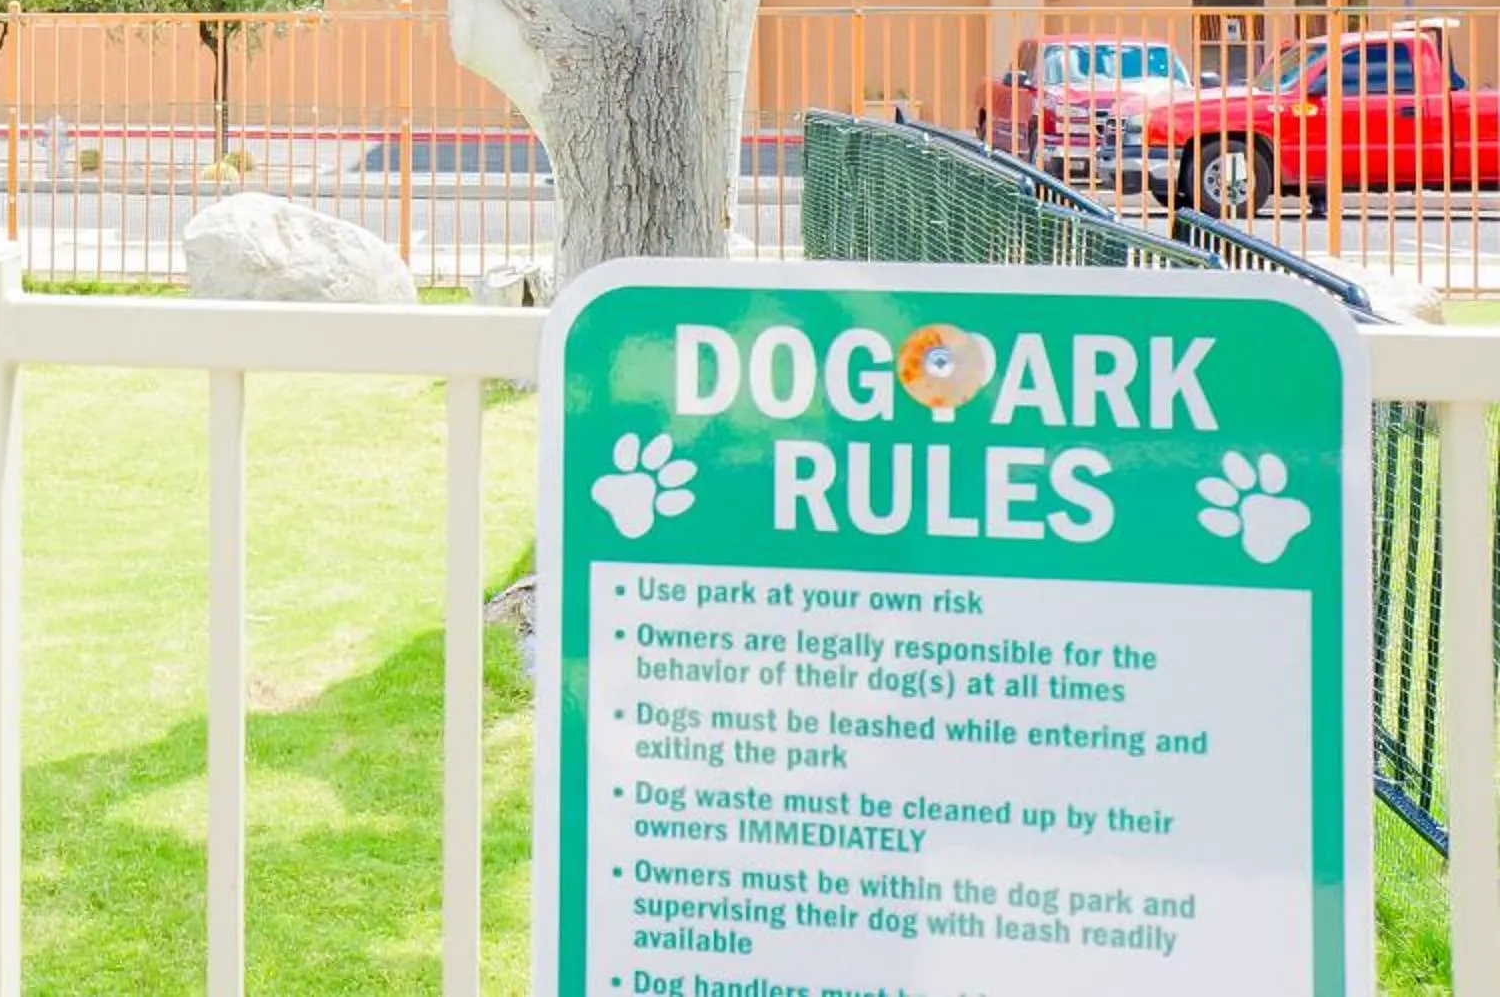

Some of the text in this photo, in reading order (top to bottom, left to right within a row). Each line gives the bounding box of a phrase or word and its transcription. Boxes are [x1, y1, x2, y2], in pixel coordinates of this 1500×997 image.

[675, 323, 895, 422] DOG
[773, 439, 1115, 543] RULES
[637, 574, 984, 615] Use park at your own risk
[636, 622, 1158, 671] Owners are legally responsible for the
[636, 655, 1127, 703] behavior of their dog(s) at all times
[634, 734, 849, 771] exiting the park
[636, 701, 1210, 759] Dogs must be leashed while entering and
[634, 779, 1176, 837] Dog waste must be cleaned up by their
[633, 816, 928, 854] owners IMMEDIATELY
[633, 858, 1198, 921] Owners must be within the dog park and
[632, 895, 1179, 959] supervising their dog with leash readily
[632, 927, 755, 956] available
[632, 969, 686, 997] Dog
[693, 973, 812, 997] handlers
